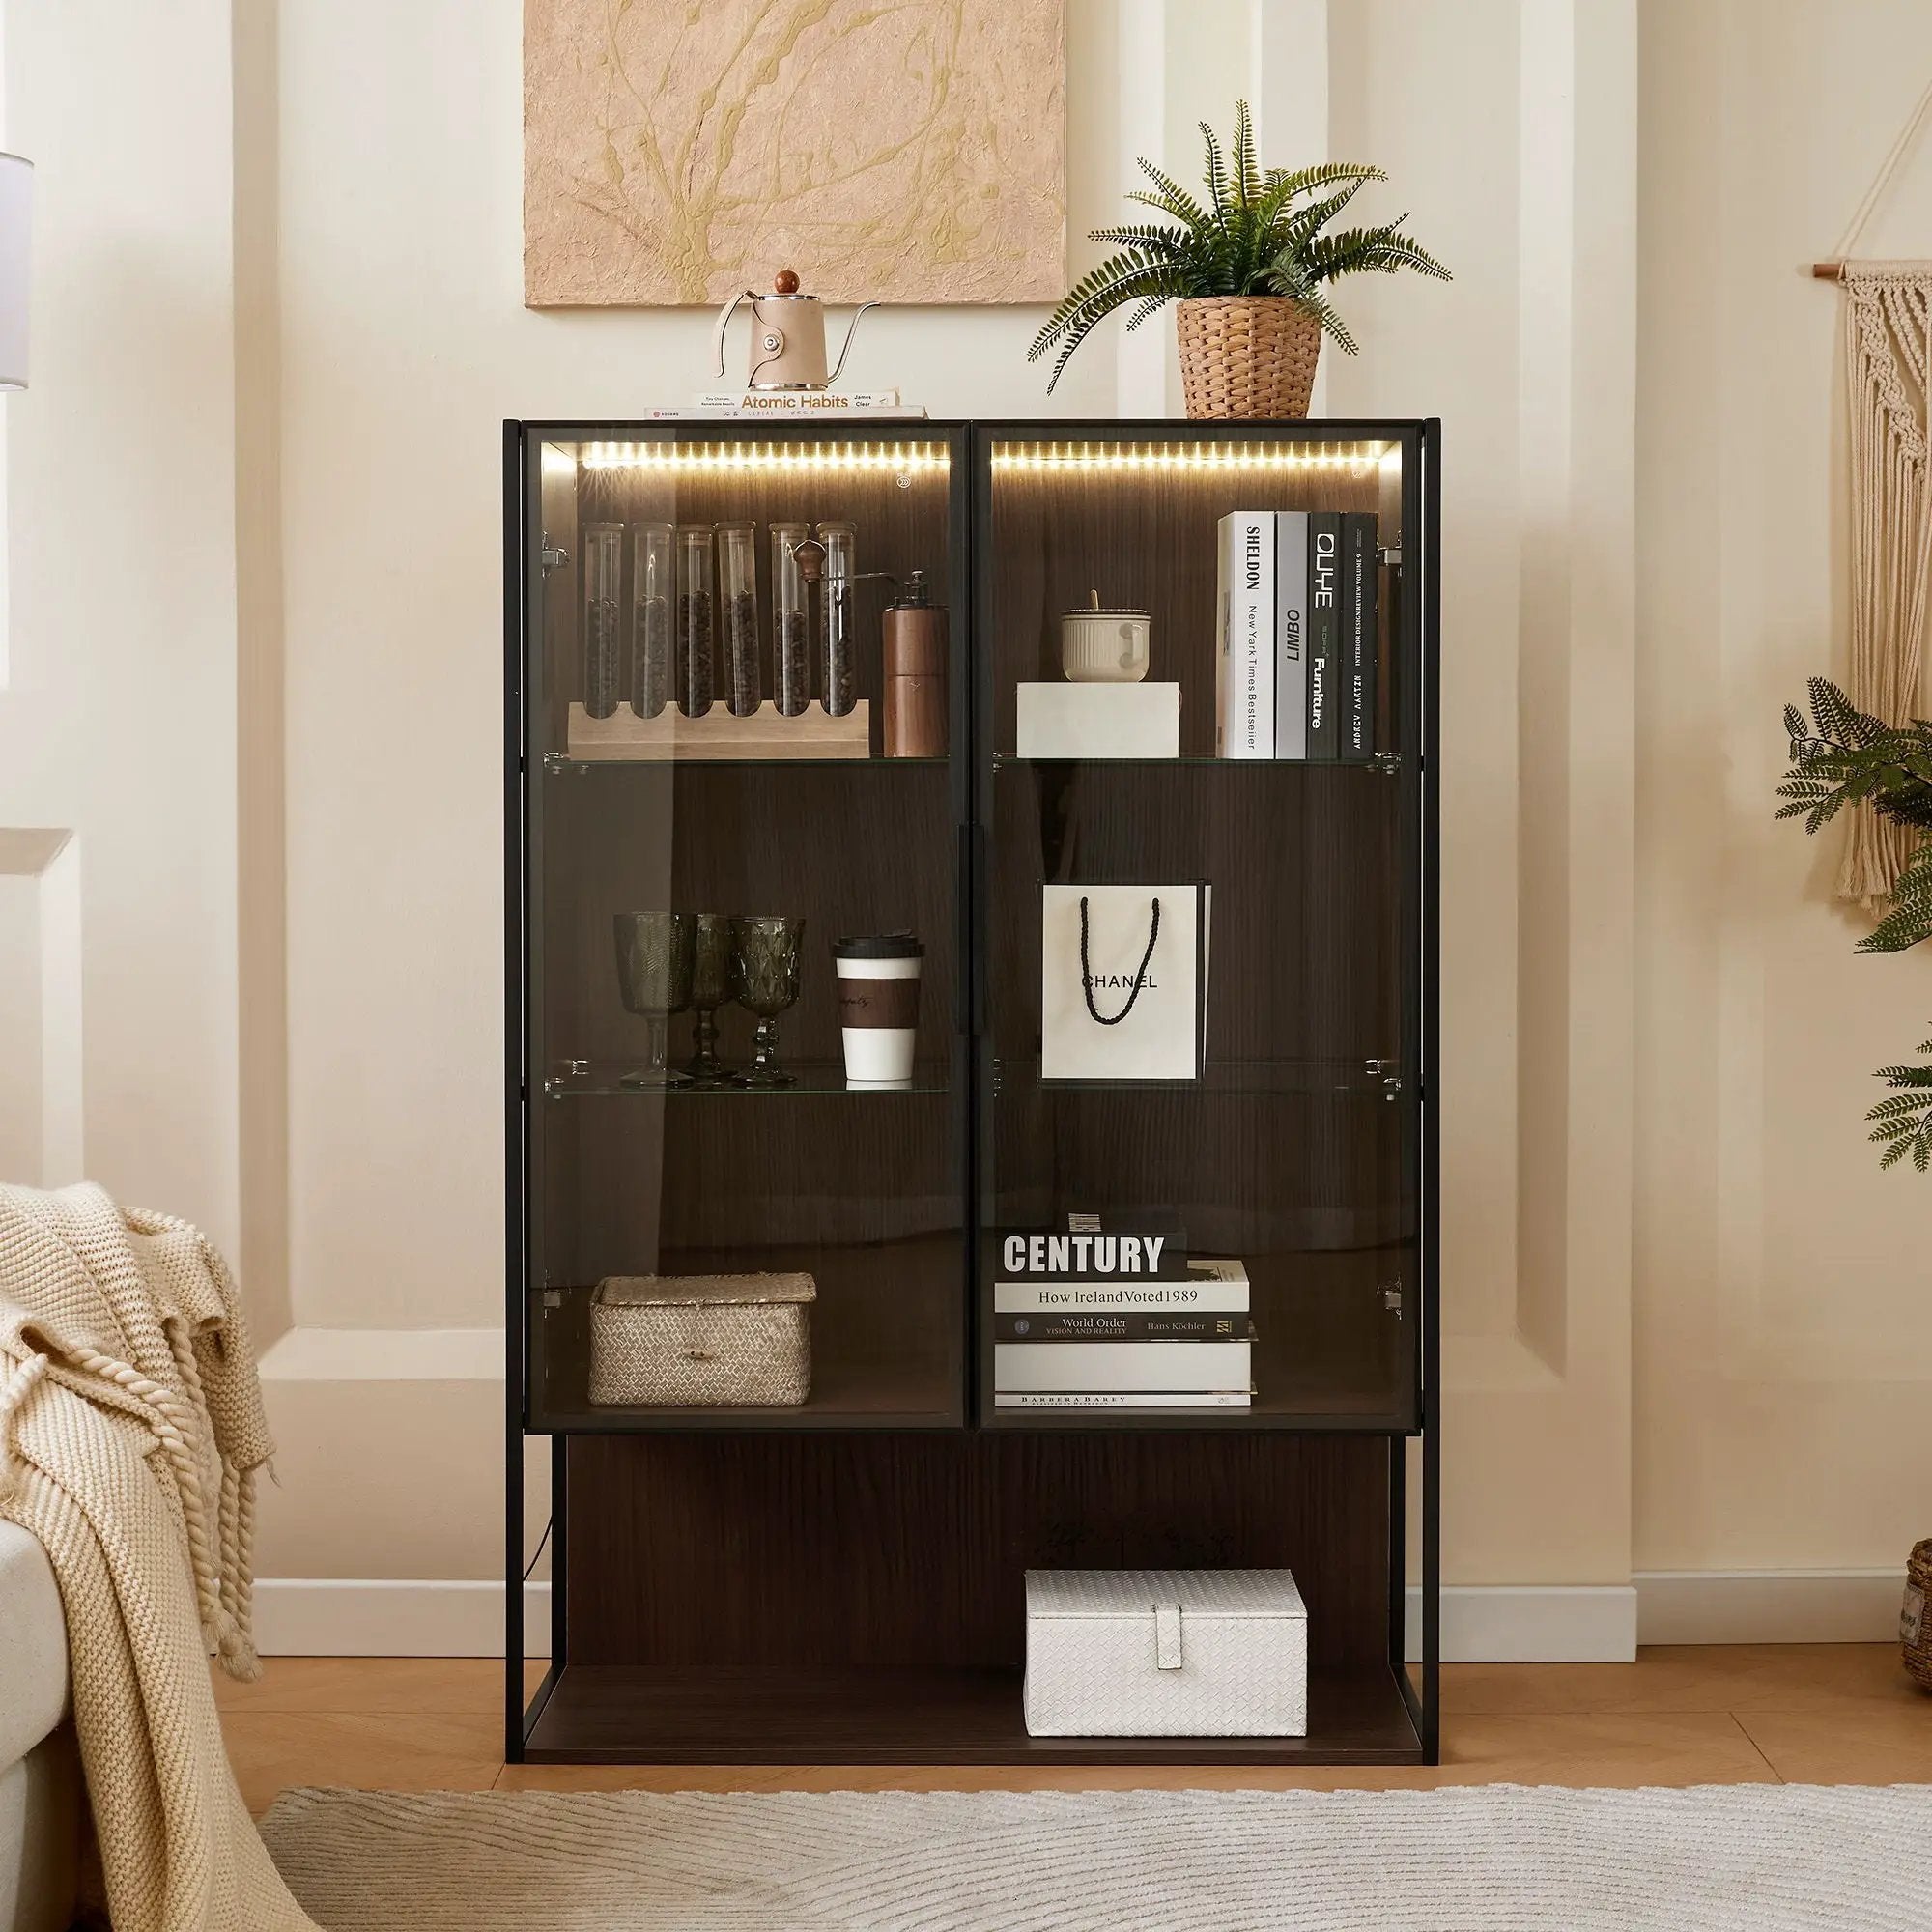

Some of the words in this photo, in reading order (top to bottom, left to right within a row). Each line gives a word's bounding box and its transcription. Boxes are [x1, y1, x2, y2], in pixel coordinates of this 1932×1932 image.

[741, 395, 796, 409] Atomic
[800, 394, 849, 408] Habits
[1246, 526, 1261, 590] SHELDON
[1248, 605, 1258, 629] New
[1286, 609, 1300, 662] LIMBO
[1248, 659, 1258, 692] Times
[1311, 657, 1325, 729] Furniture
[1004, 1236, 1165, 1273] CENTURY
[1039, 1291, 1071, 1304] How
[1062, 1318, 1095, 1329] World
[1096, 1318, 1127, 1329] Order
